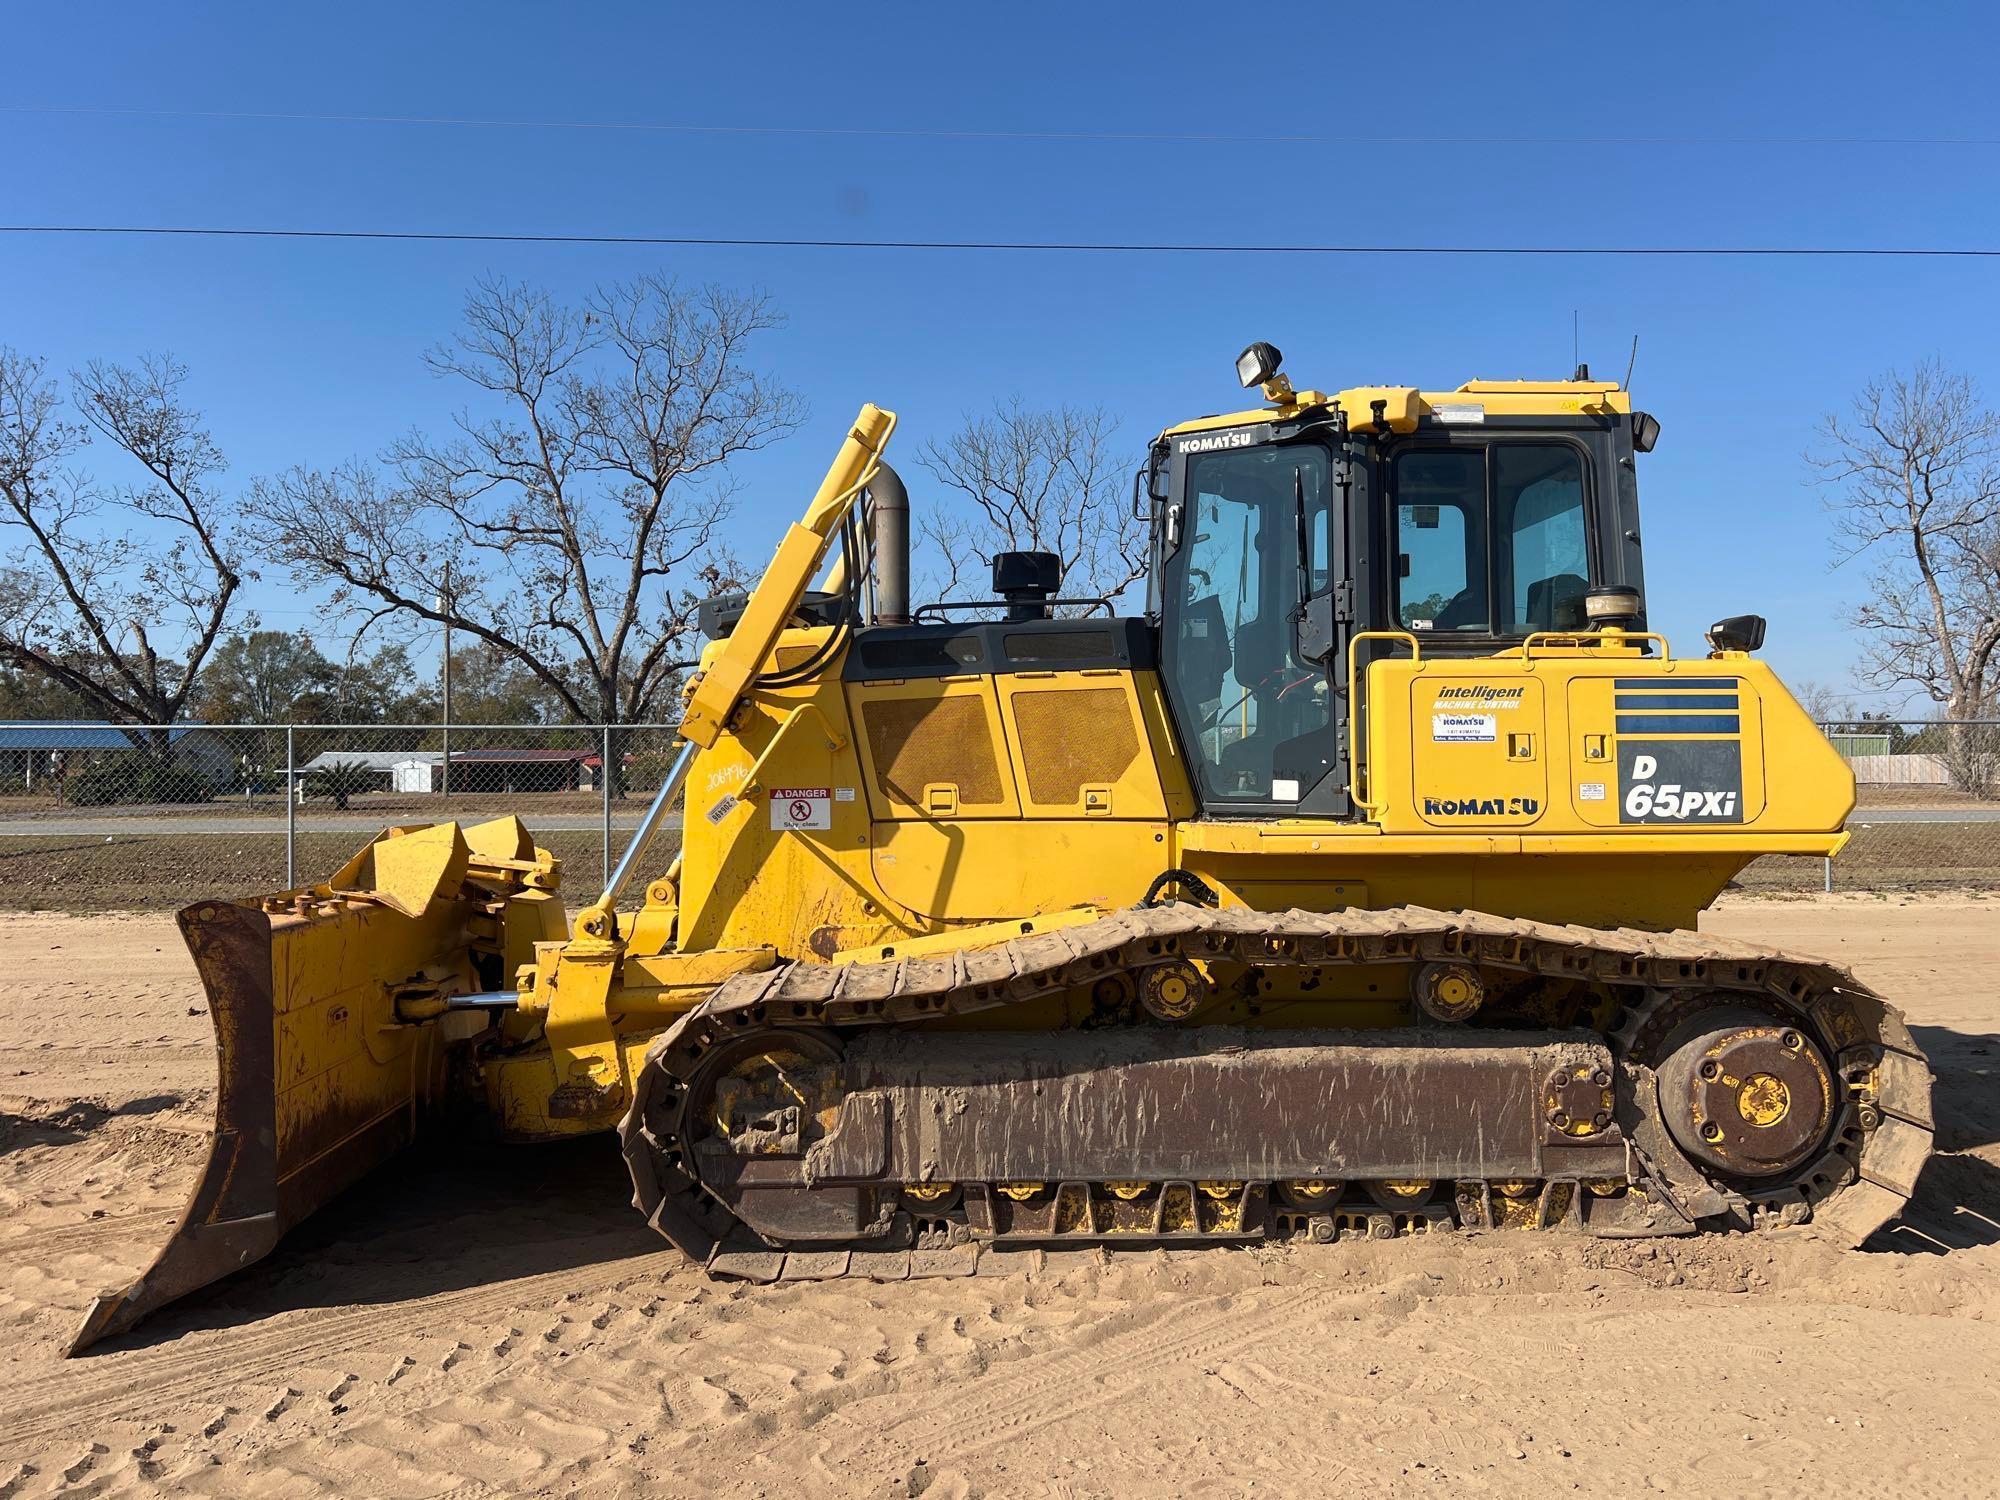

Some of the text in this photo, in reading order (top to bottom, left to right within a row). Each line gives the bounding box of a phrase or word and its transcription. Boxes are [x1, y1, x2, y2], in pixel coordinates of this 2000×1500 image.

[1179, 432, 1251, 453] KOMATSU
[1438, 686, 1525, 701] intelligent
[1432, 700, 1520, 709] MACHINE CONTROL
[1631, 755, 1658, 780] D
[785, 789, 827, 798] DANGER
[1625, 784, 1737, 818] 65PXi
[1424, 798, 1538, 816] KOMATSU
